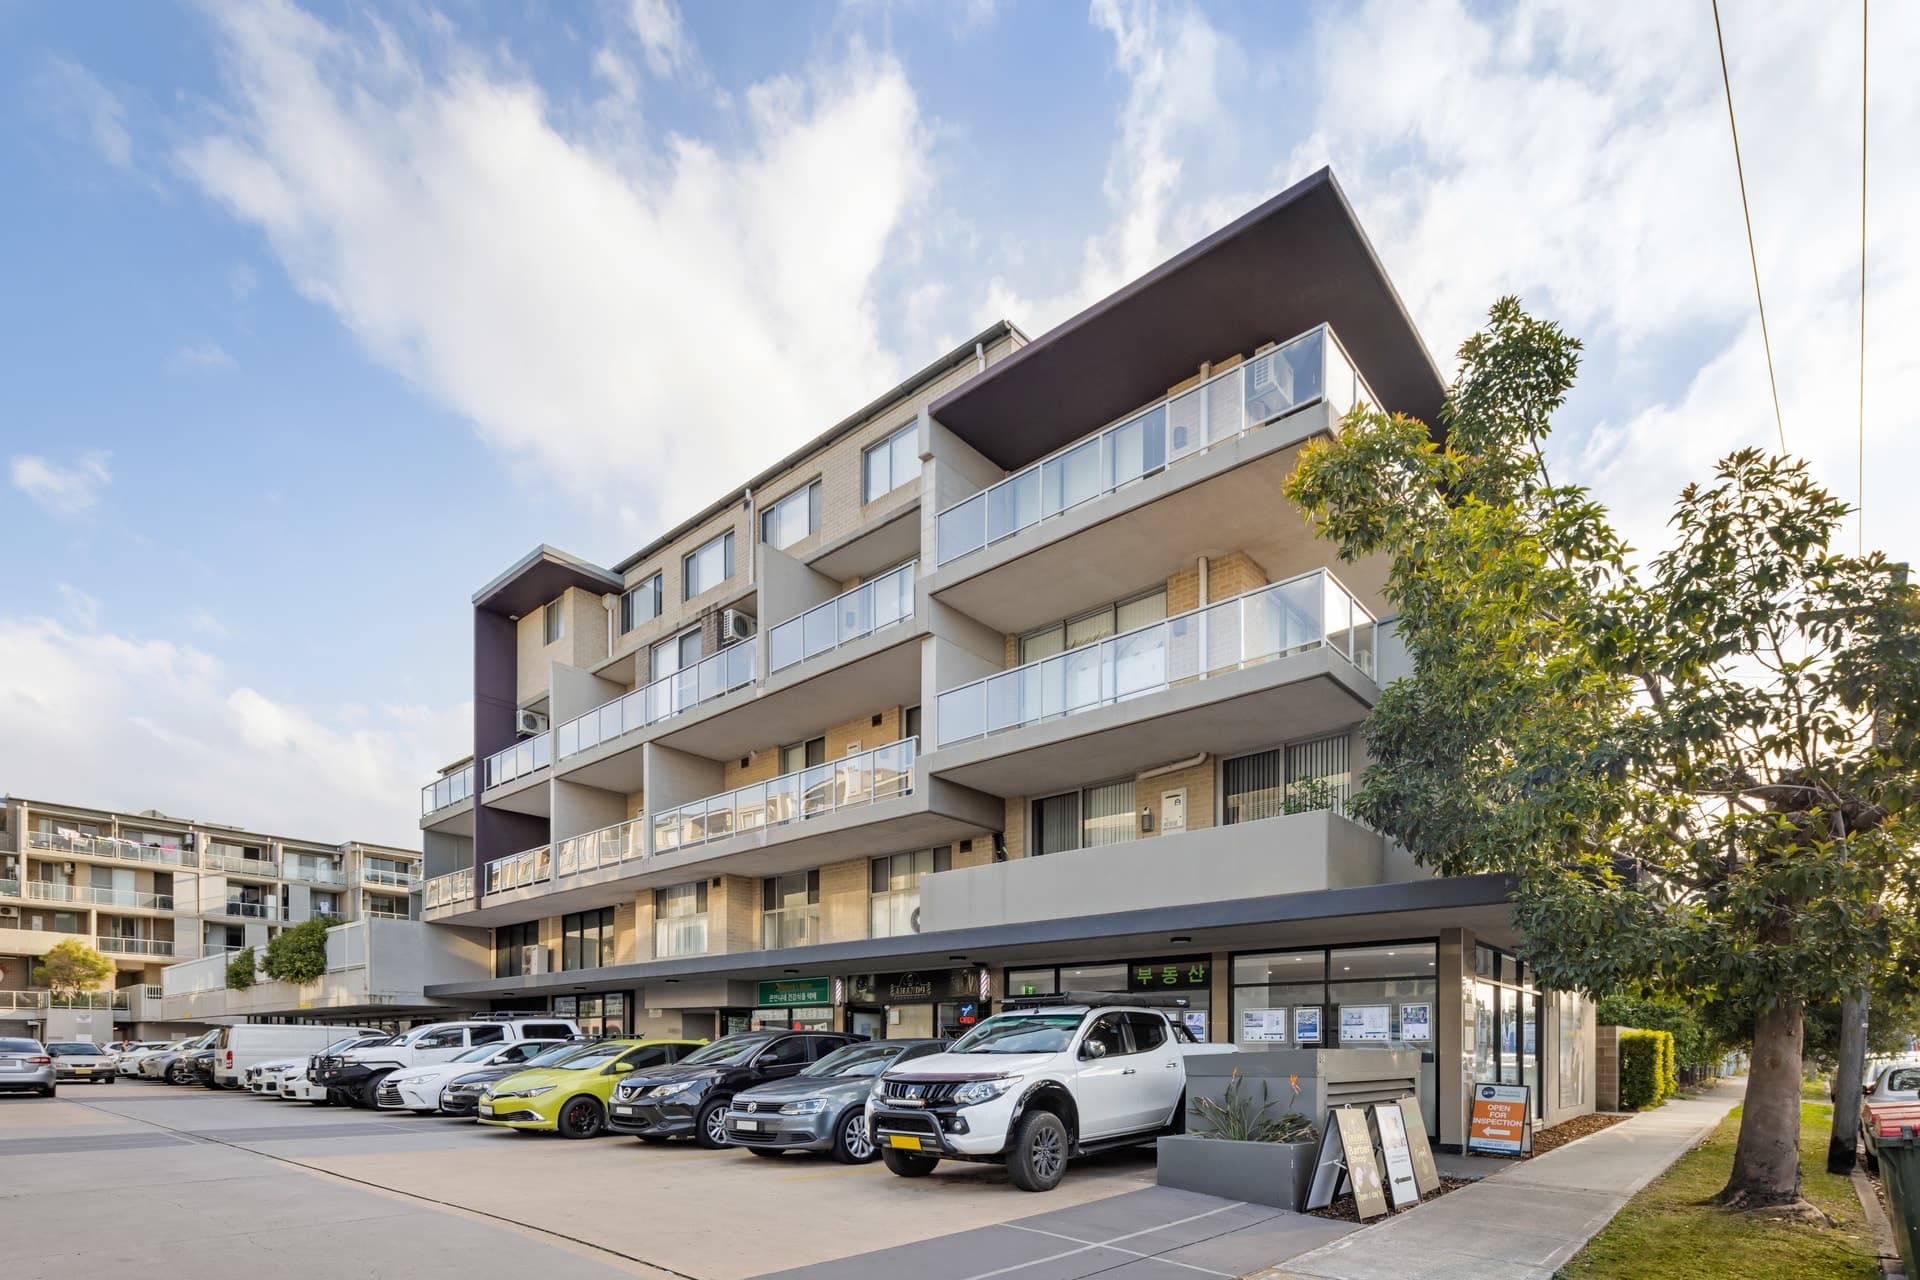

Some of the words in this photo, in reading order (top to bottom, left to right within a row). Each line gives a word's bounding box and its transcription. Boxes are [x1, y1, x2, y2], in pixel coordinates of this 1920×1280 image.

[1137, 964, 1205, 985] 부동산
[1488, 1104, 1511, 1112] OPEN
[1473, 1117, 1522, 1127] INSPECTION
